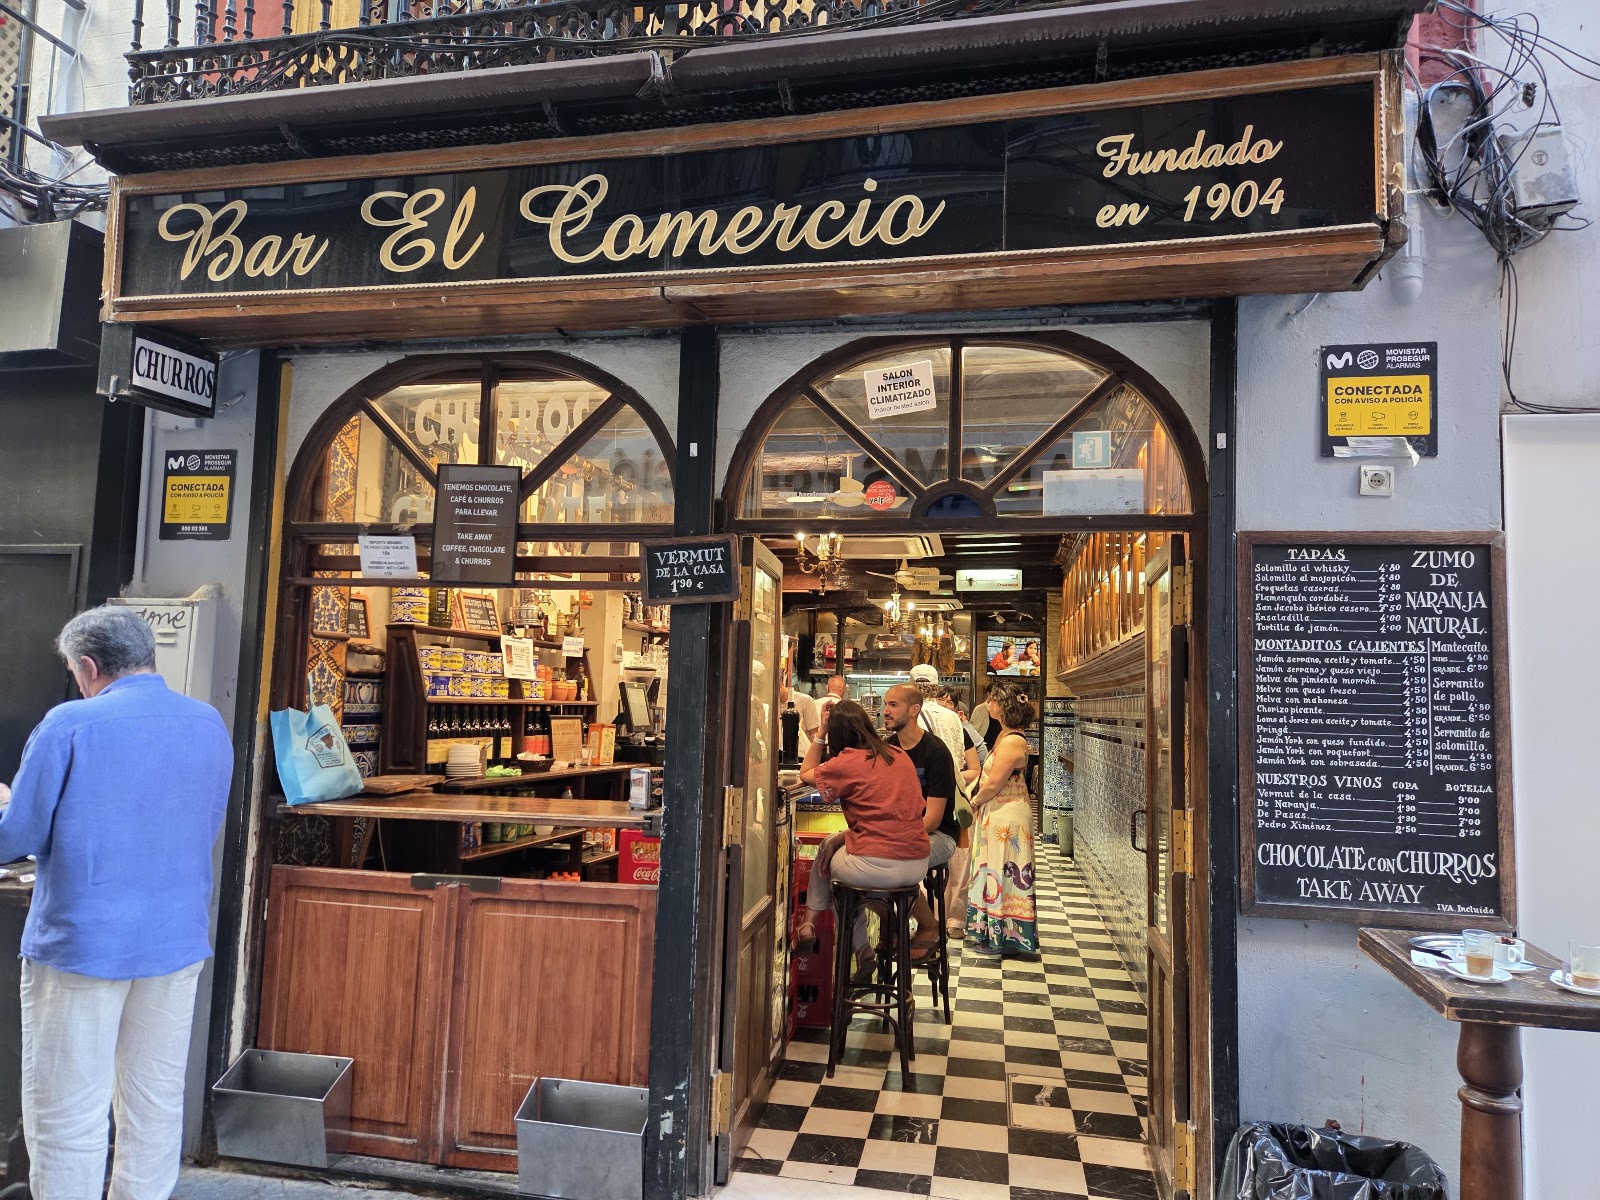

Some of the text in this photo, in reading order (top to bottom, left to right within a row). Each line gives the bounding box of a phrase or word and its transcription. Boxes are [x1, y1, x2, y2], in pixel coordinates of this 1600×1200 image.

[1096, 124, 1283, 178] Fundado
[1096, 177, 1285, 228] en 1904
[157, 174, 945, 282] Bar El Comercio
[1386, 348, 1427, 356] MOVISTAR
[135, 346, 214, 399] CHURROS
[883, 369, 913, 381] SALON
[878, 379, 921, 393] INTERIOR
[1334, 384, 1423, 396] CONECTADA
[870, 388, 931, 405] CLIMATIZADO
[1389, 395, 1423, 403] POLICÍA
[170, 483, 225, 491] CONECTADA
[444, 483, 513, 493] TENEMOS CHOCOLATE,
[450, 495, 504, 504] CAFÉ & CHURROS
[869, 496, 886, 505] yelp
[455, 508, 498, 517] PARA LLEVAR
[474, 533, 493, 541] AWAY
[442, 544, 506, 554] COFFEE, CHOCOLATE
[1288, 548, 1346, 560] TAPAS
[455, 557, 491, 566] & CHURROS
[654, 547, 725, 566] VERMUT
[1411, 550, 1475, 569] ZUMO
[656, 564, 725, 578] DE LA CASA
[1255, 563, 1297, 572] Solomillo
[1301, 564, 1310, 572] al
[1255, 574, 1296, 582] Solomillo
[1430, 572, 1459, 588] DE
[671, 579, 704, 593] 1'90 €
[1255, 584, 1299, 594] Croquetas
[1255, 593, 1307, 604] Flamenquín
[1405, 591, 1488, 614] NARANJA
[1255, 603, 1273, 611] San
[1274, 604, 1304, 612] Jacobo
[1306, 603, 1337, 612] ibérico
[1256, 623, 1290, 632] Tortilla
[1294, 624, 1304, 632] de
[1406, 617, 1487, 639] NATURAL.
[1254, 639, 1426, 653] MONTADITOS CALIENTES
[1256, 654, 1284, 663] Jamón
[1324, 656, 1350, 664] aceite
[1350, 657, 1358, 666] y
[1256, 665, 1283, 673] Jamón
[1330, 667, 1354, 676] queso
[1432, 666, 1461, 675] GRANDE
[1256, 674, 1281, 683] Melva
[1301, 676, 1338, 685] pimiento
[1432, 678, 1484, 689] Serranito
[1256, 684, 1281, 693] Melva
[1302, 687, 1325, 696] queso
[1256, 695, 1281, 703] Melva
[1433, 691, 1447, 701] de
[1256, 705, 1289, 713] Chorizo
[1256, 715, 1277, 723] Lomo
[1289, 716, 1309, 724] Jerez
[1326, 717, 1350, 725] aceite
[1434, 715, 1461, 724] GRANDE
[1433, 726, 1490, 738] Serranito de
[1256, 735, 1283, 744] Jamón
[1284, 736, 1304, 744] York
[1322, 739, 1344, 748] queso
[1285, 746, 1305, 755] York
[1287, 757, 1307, 766] York
[1435, 764, 1464, 772] GRANDE
[1256, 772, 1493, 793] NUESTROS VINOS COPA BOTELLA
[1257, 788, 1294, 798] Vermut
[1313, 791, 1323, 799] la
[1257, 799, 1269, 807] De
[1257, 809, 1269, 818] De
[1257, 819, 1287, 829] Pedro
[1395, 825, 1416, 835] 2'50
[1257, 843, 1497, 884] CHOCOLATE CON CHURROS
[1297, 877, 1425, 904] TAKE AWAY
[1457, 905, 1495, 915] Incluido
